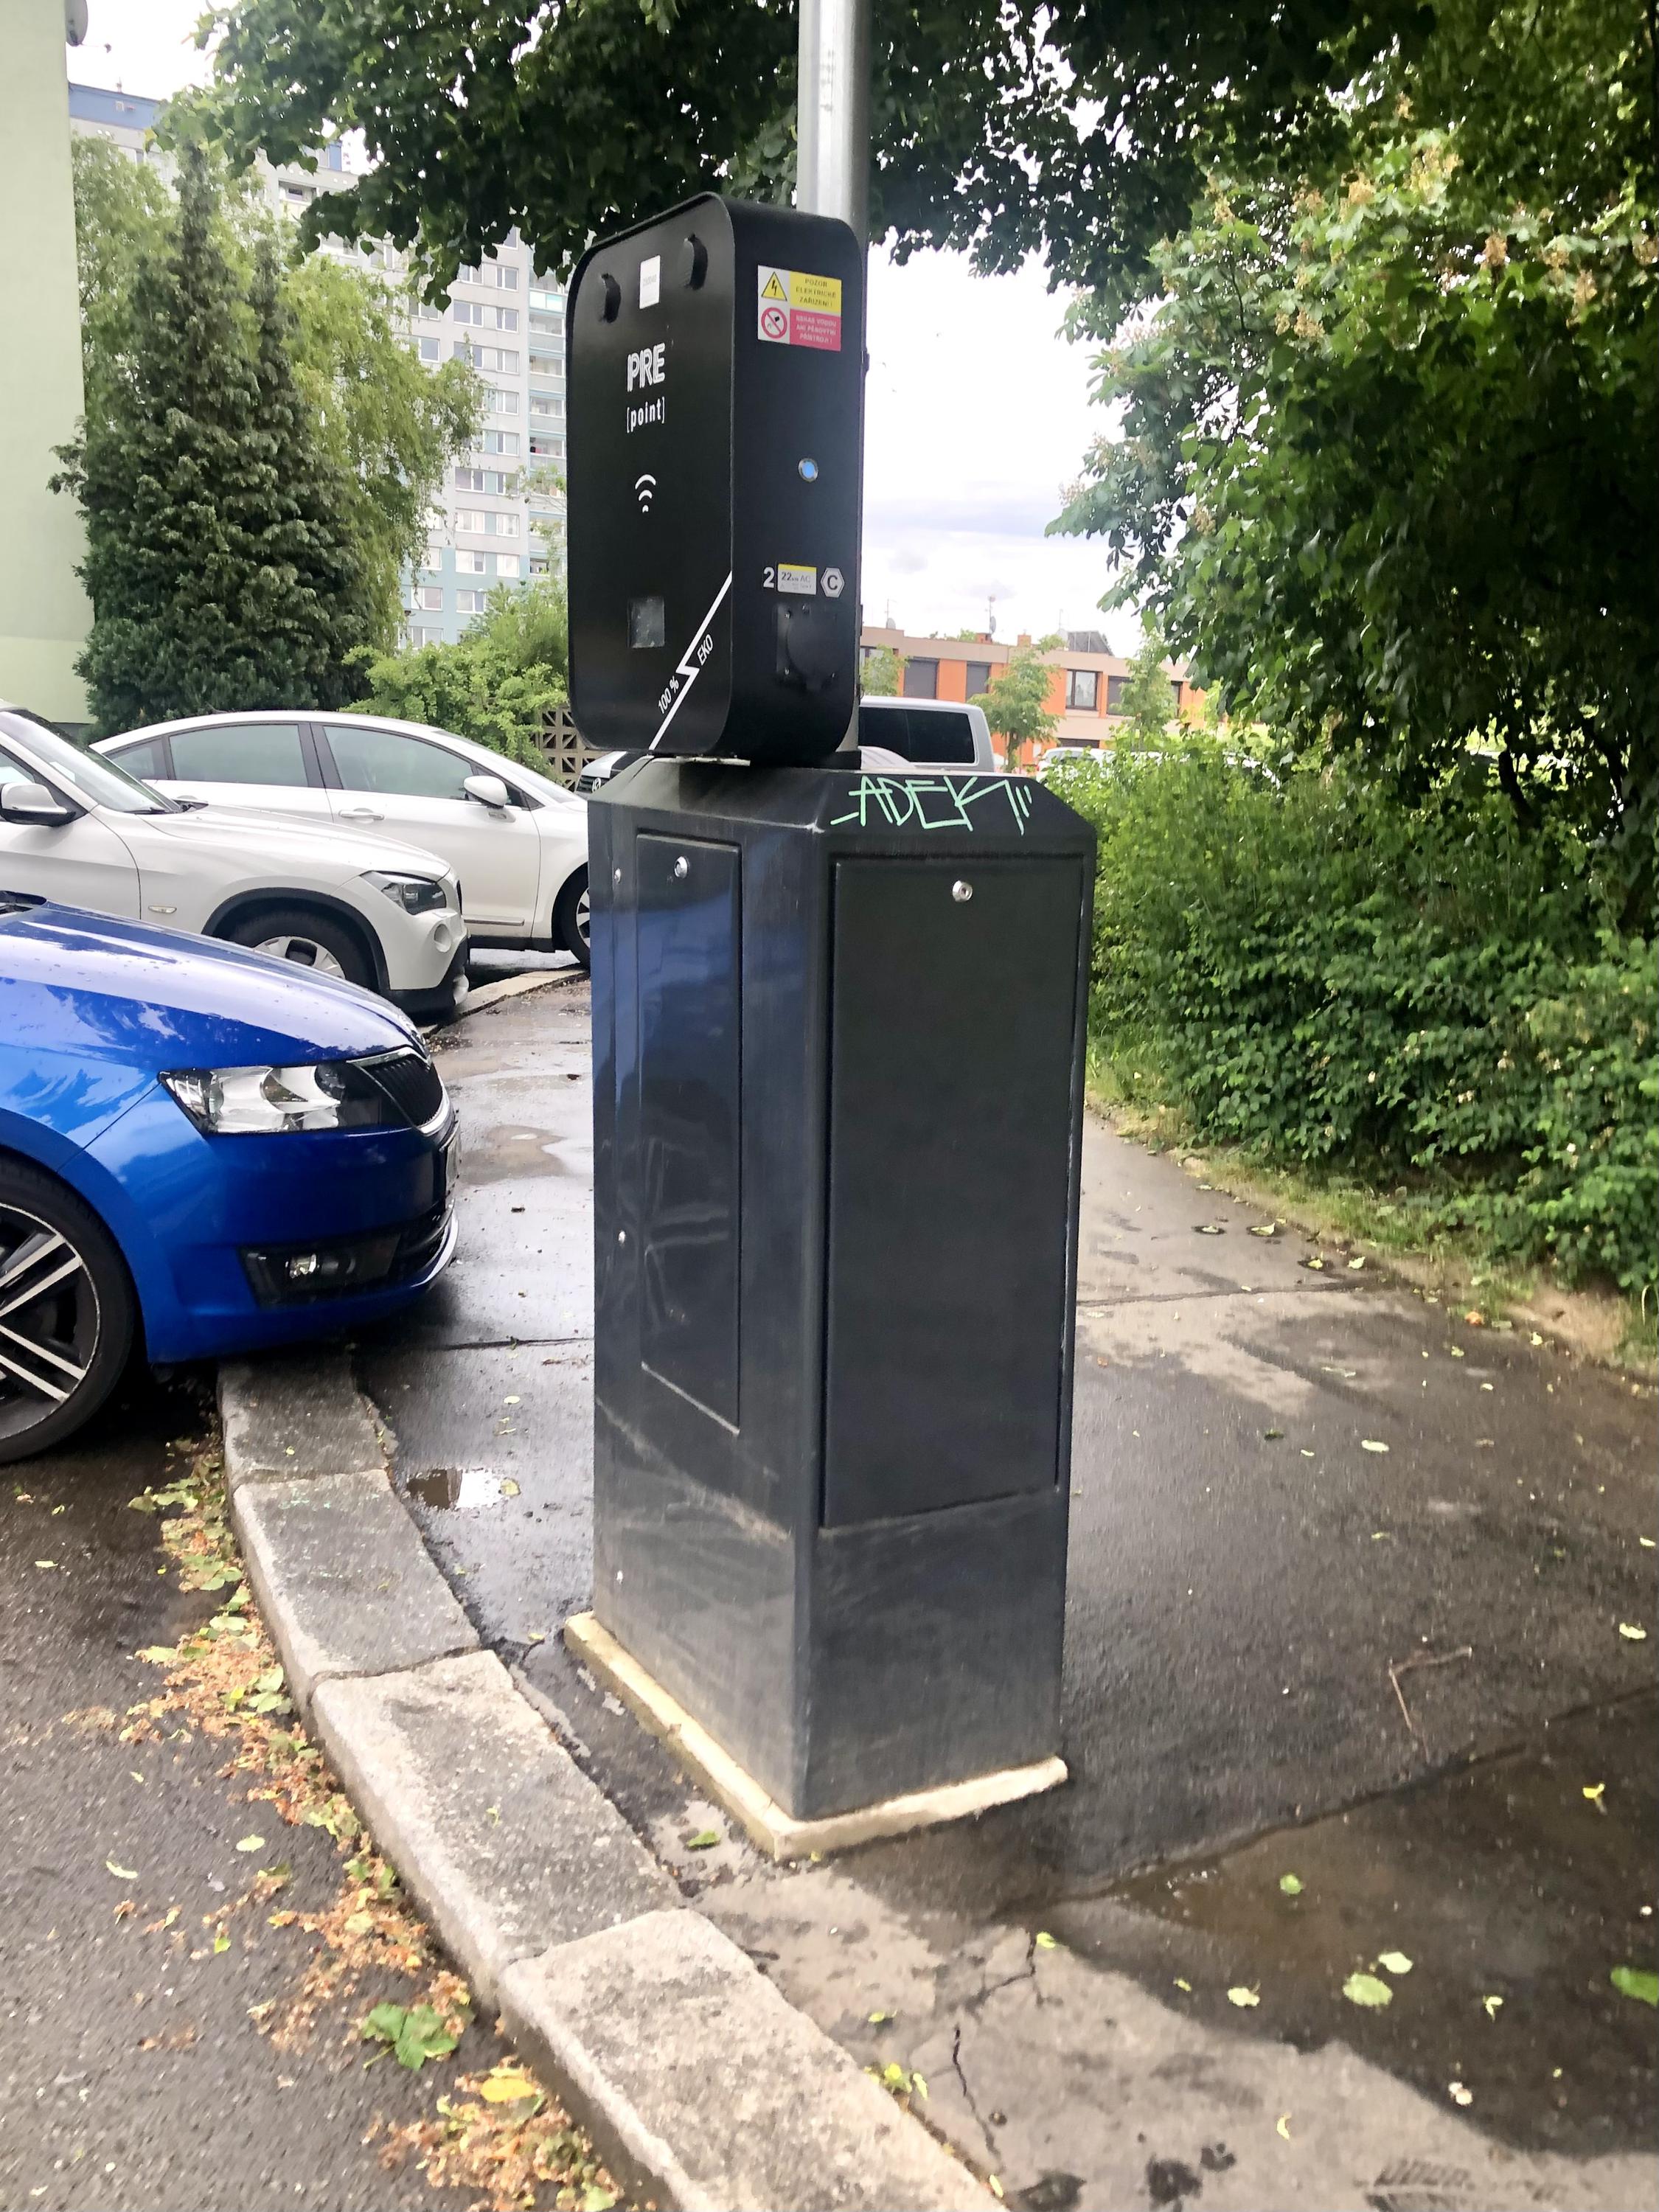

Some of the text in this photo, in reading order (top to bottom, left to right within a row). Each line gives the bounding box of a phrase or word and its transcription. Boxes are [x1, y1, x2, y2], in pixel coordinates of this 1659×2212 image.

[804, 278, 827, 288] POZOR
[627, 342, 666, 392] PRE
[763, 566, 775, 588] 2
[827, 575, 838, 590] C
[658, 687, 672, 714] 100
[697, 633, 714, 666] EKO
